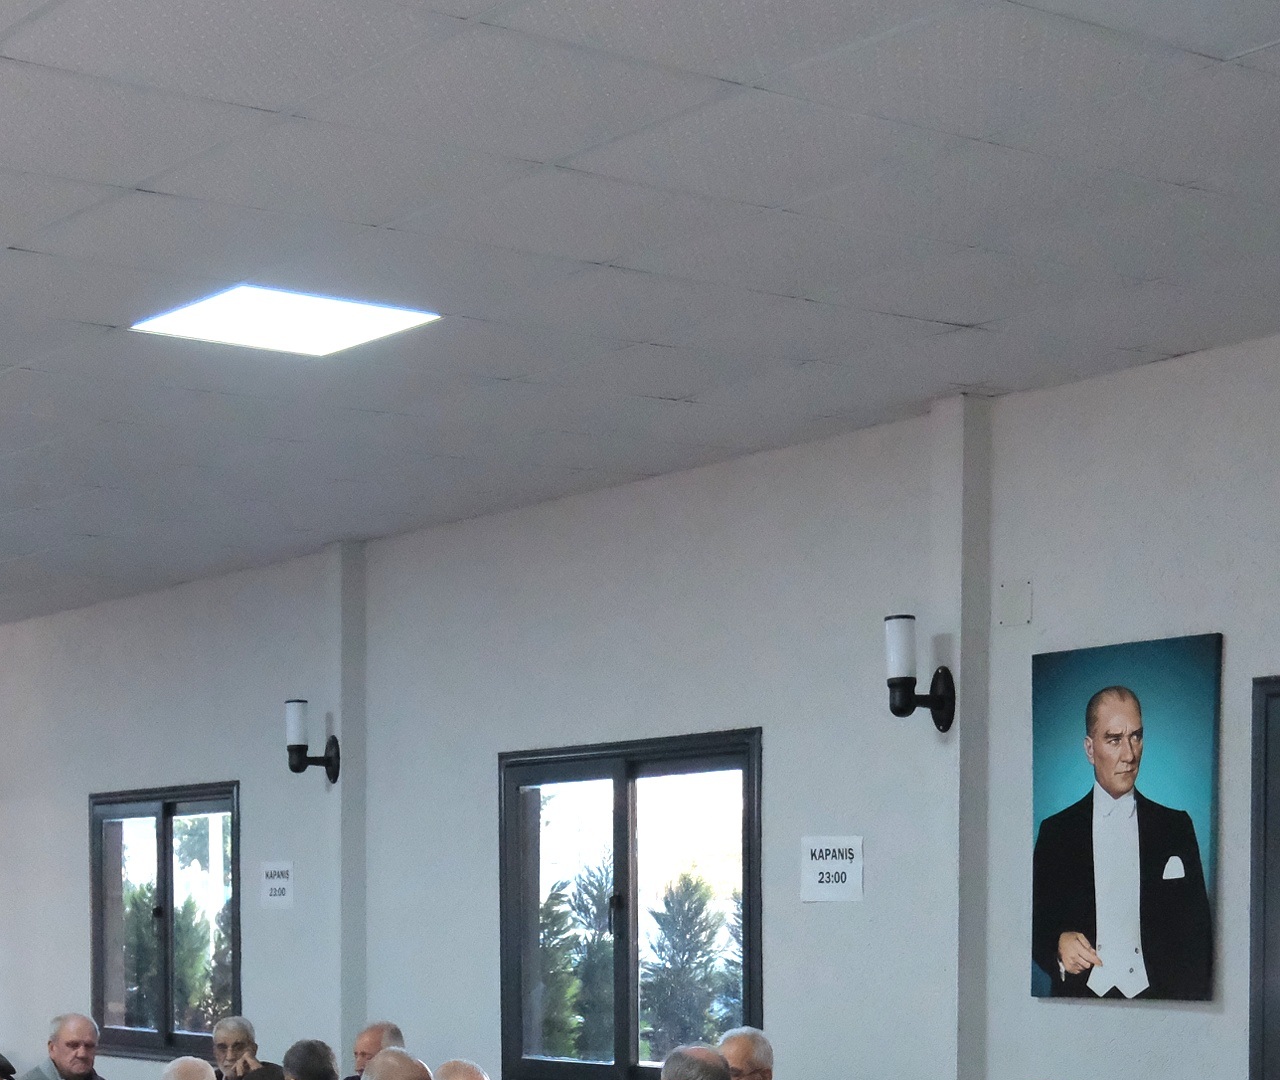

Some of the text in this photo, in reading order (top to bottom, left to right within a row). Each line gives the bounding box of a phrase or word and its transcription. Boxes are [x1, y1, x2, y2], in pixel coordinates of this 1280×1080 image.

[810, 848, 855, 864] KAPANIŞ
[817, 871, 847, 884] 23:00
[268, 887, 287, 897] 23:00
